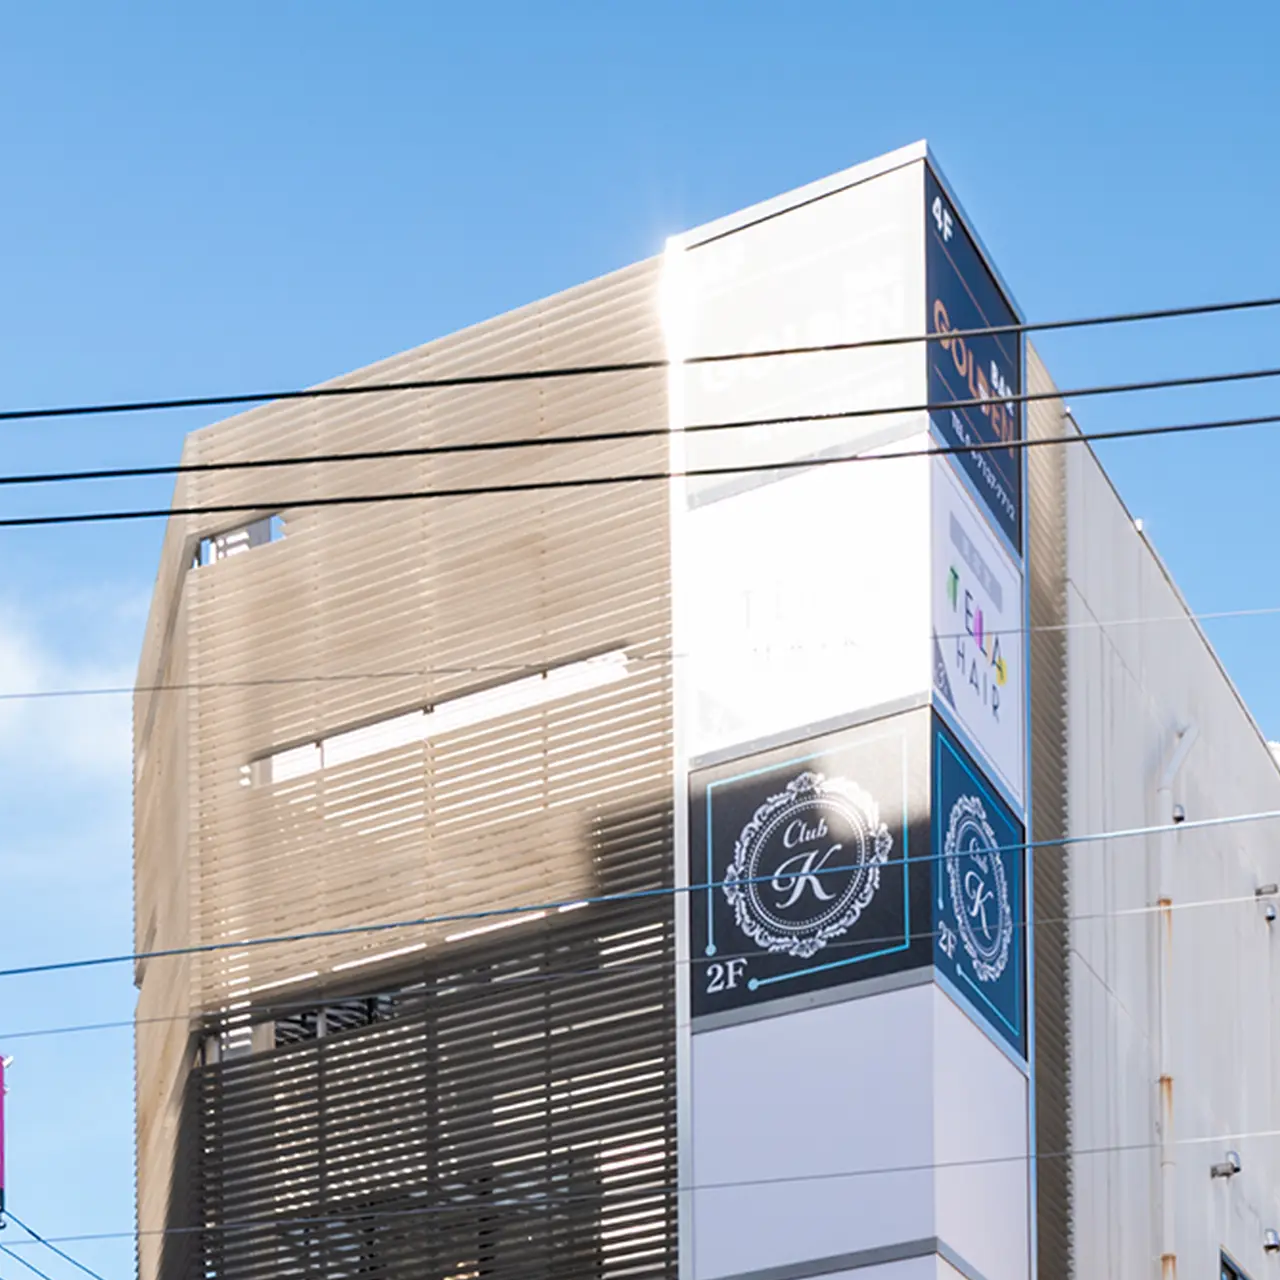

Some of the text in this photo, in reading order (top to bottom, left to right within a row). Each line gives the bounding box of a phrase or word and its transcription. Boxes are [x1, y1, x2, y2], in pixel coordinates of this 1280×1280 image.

[932, 196, 953, 242] 4F
[933, 298, 1014, 460] GOLDEN
[949, 565, 1003, 683] TELA
[956, 636, 1000, 724] HAIR
[782, 817, 829, 850] Club
[771, 844, 842, 910] K
[964, 871, 994, 941] K
[938, 919, 958, 961] 2F
[706, 957, 748, 994] 2F
